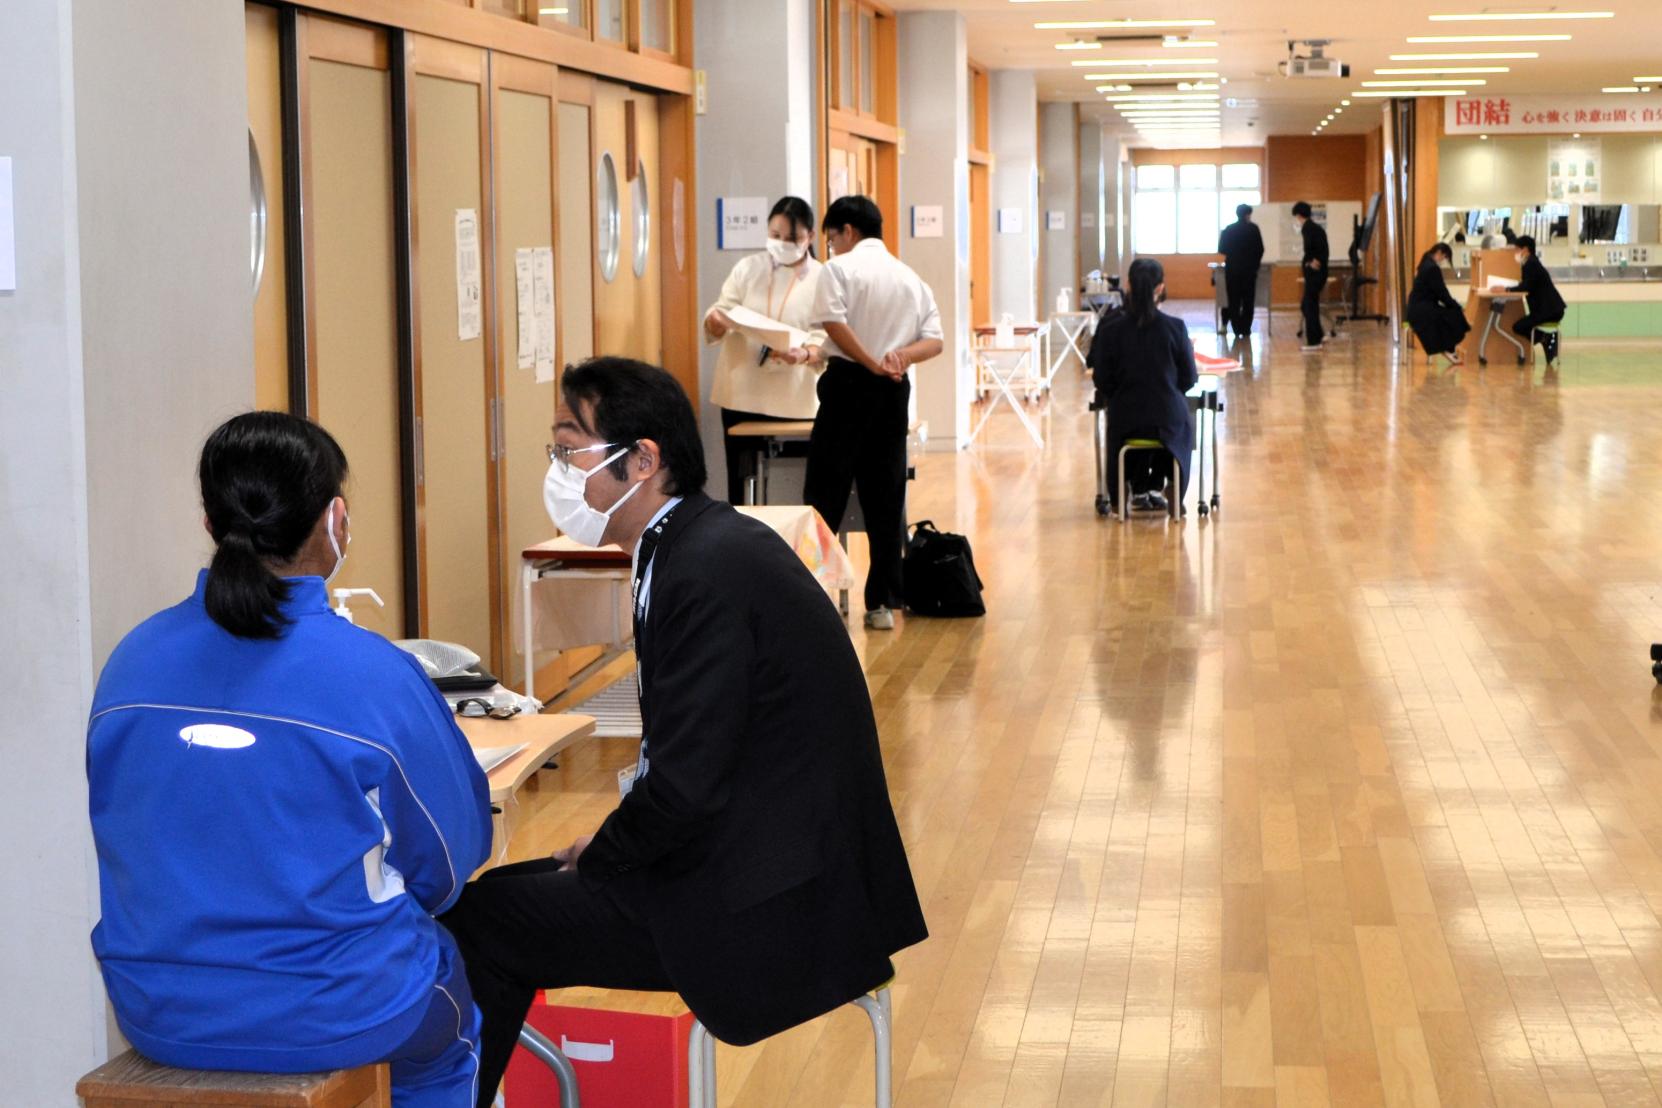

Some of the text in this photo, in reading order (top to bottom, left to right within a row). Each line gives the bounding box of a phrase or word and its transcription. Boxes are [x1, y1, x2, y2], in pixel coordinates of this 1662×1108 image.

[1456, 99, 1510, 126] 団結
[1575, 108, 1636, 123] 決意は固く
